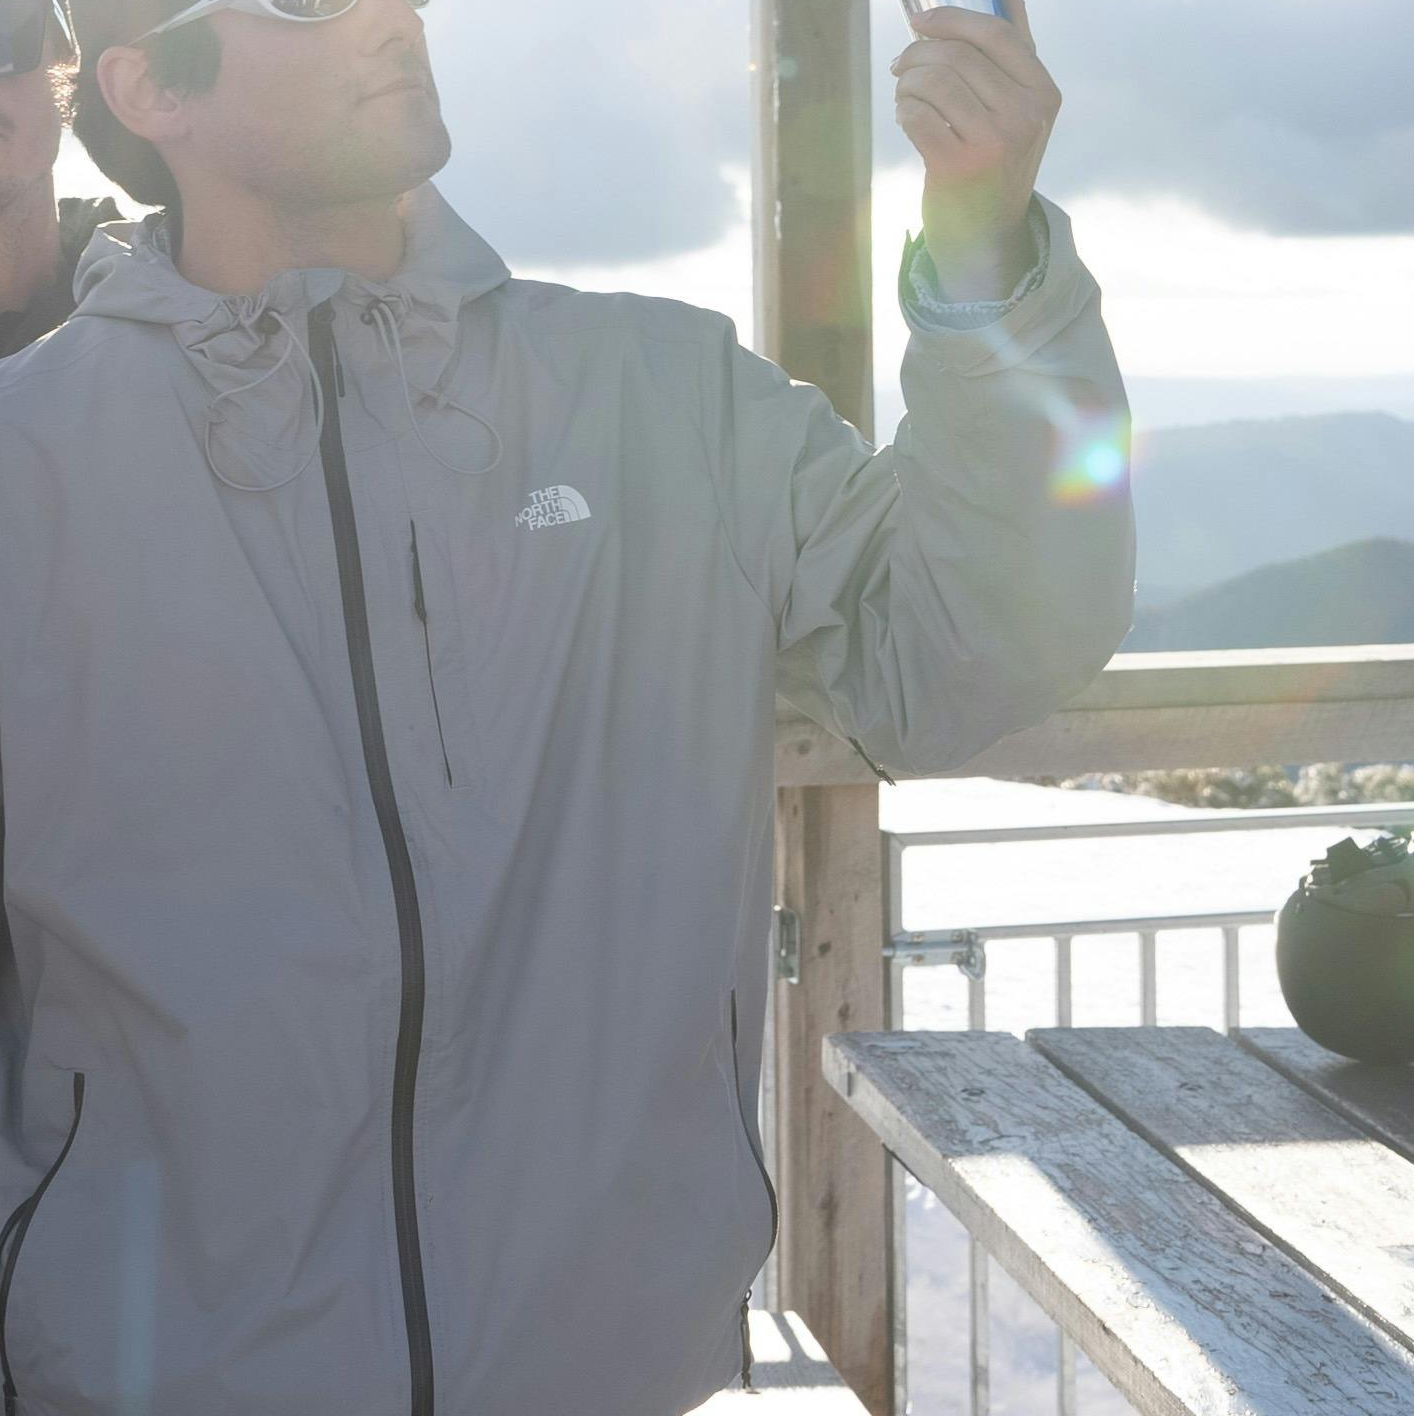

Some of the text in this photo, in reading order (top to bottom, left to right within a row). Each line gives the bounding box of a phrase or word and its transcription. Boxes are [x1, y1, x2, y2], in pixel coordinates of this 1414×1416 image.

[528, 485, 559, 504] THE
[514, 499, 562, 528] NORTH
[528, 511, 566, 531] FACE
